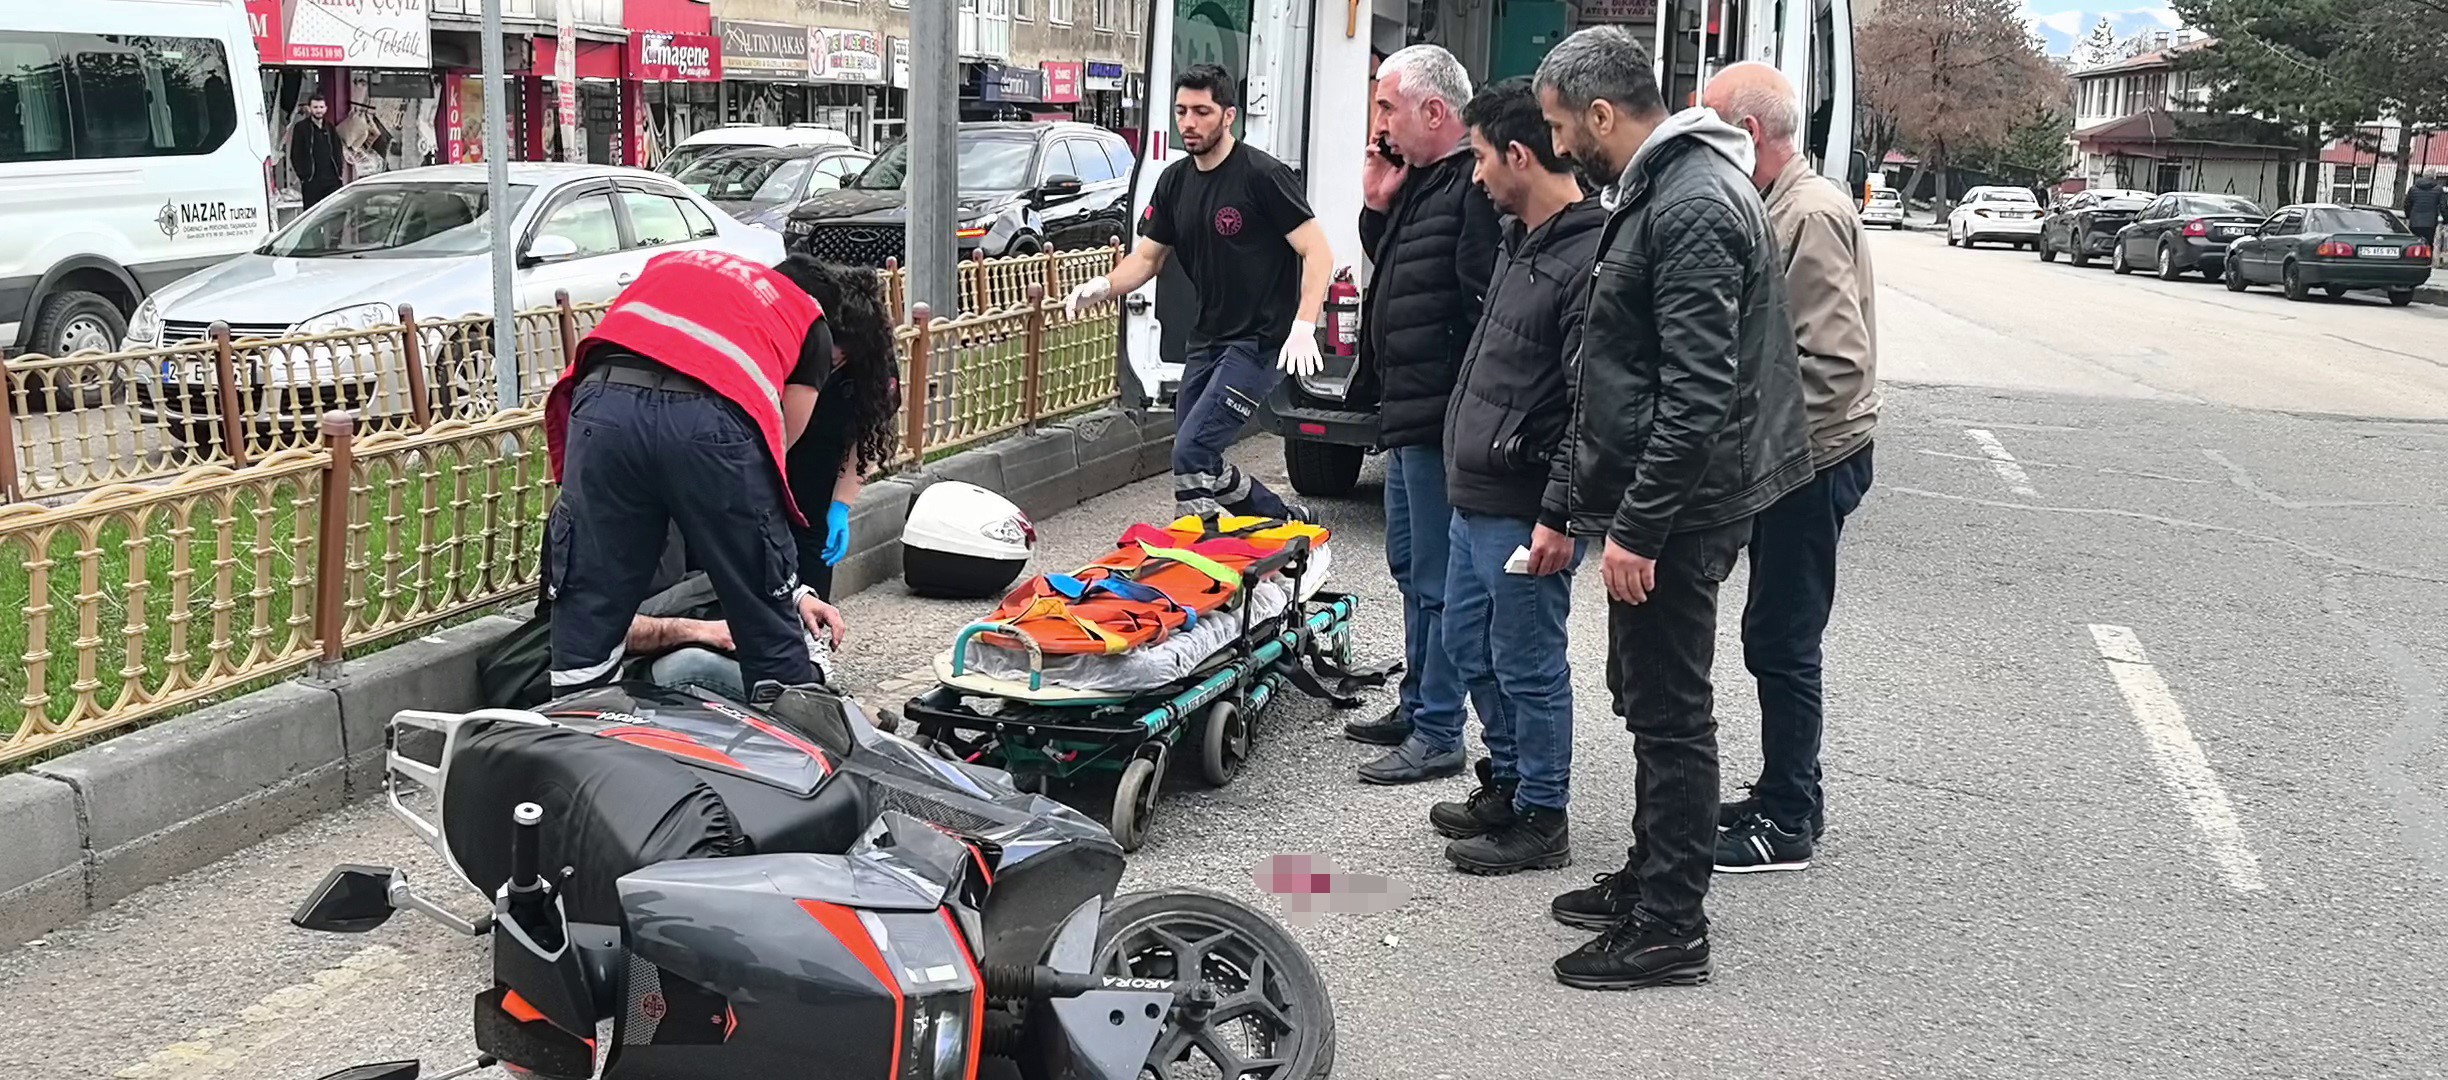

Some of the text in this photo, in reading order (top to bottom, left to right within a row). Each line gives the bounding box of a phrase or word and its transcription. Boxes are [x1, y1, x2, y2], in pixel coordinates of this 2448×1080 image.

[737, 27, 805, 58] ALTIN MAKAS
[180, 202, 227, 223] NAZAR
[1102, 975, 1175, 990] ARORA
